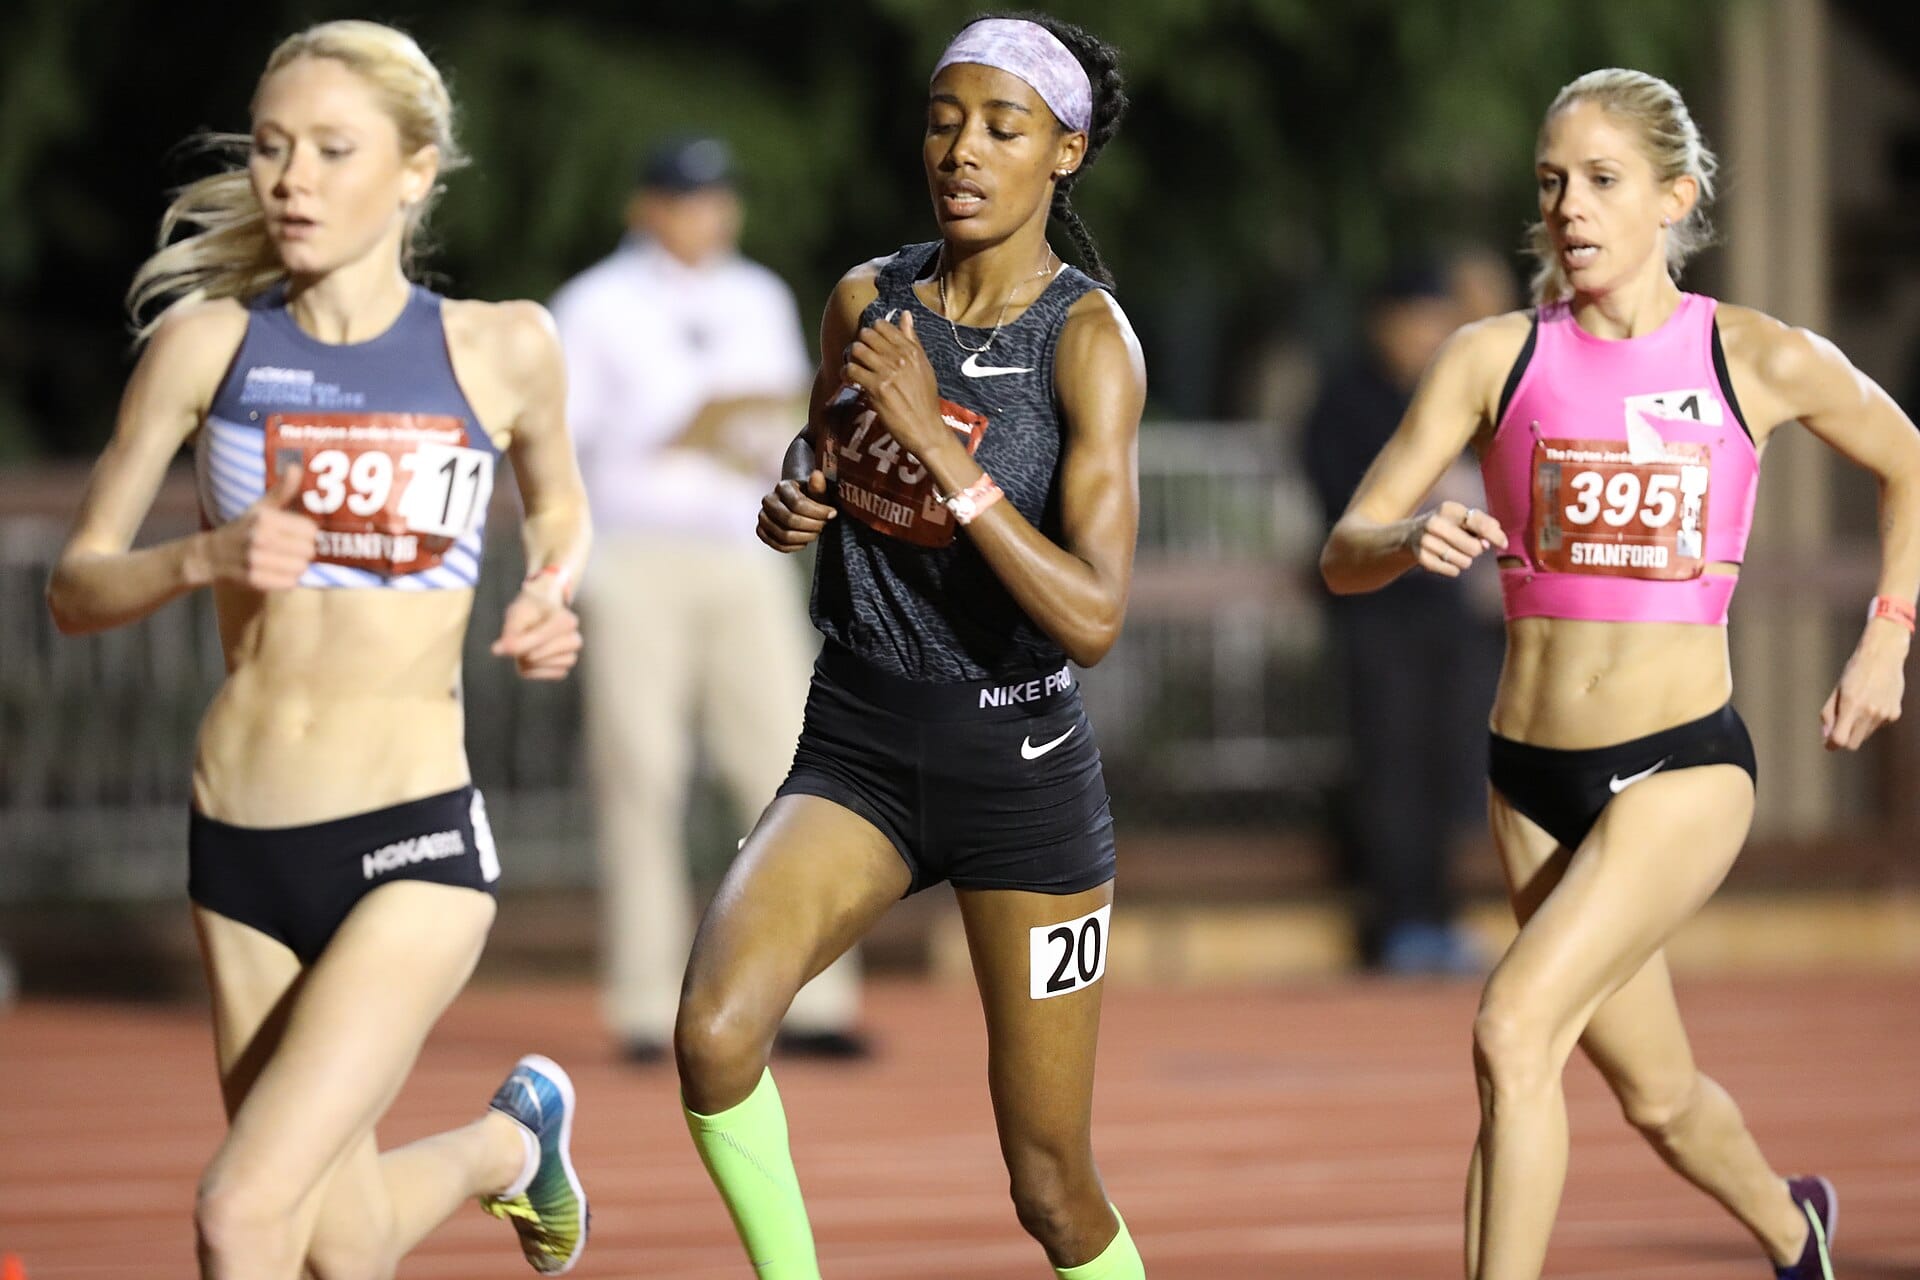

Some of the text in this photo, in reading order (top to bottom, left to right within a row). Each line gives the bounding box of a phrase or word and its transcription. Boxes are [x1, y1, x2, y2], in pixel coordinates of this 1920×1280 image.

[1546, 448, 1565, 460] The
[1566, 449, 1602, 463] Payton
[439, 456, 481, 530] 11
[837, 478, 915, 529] STANFORD
[1565, 470, 1680, 528] 395
[1570, 542, 1668, 568] STANFORD
[979, 665, 1071, 709] NIKE PRO
[1046, 917, 1101, 994] 20
